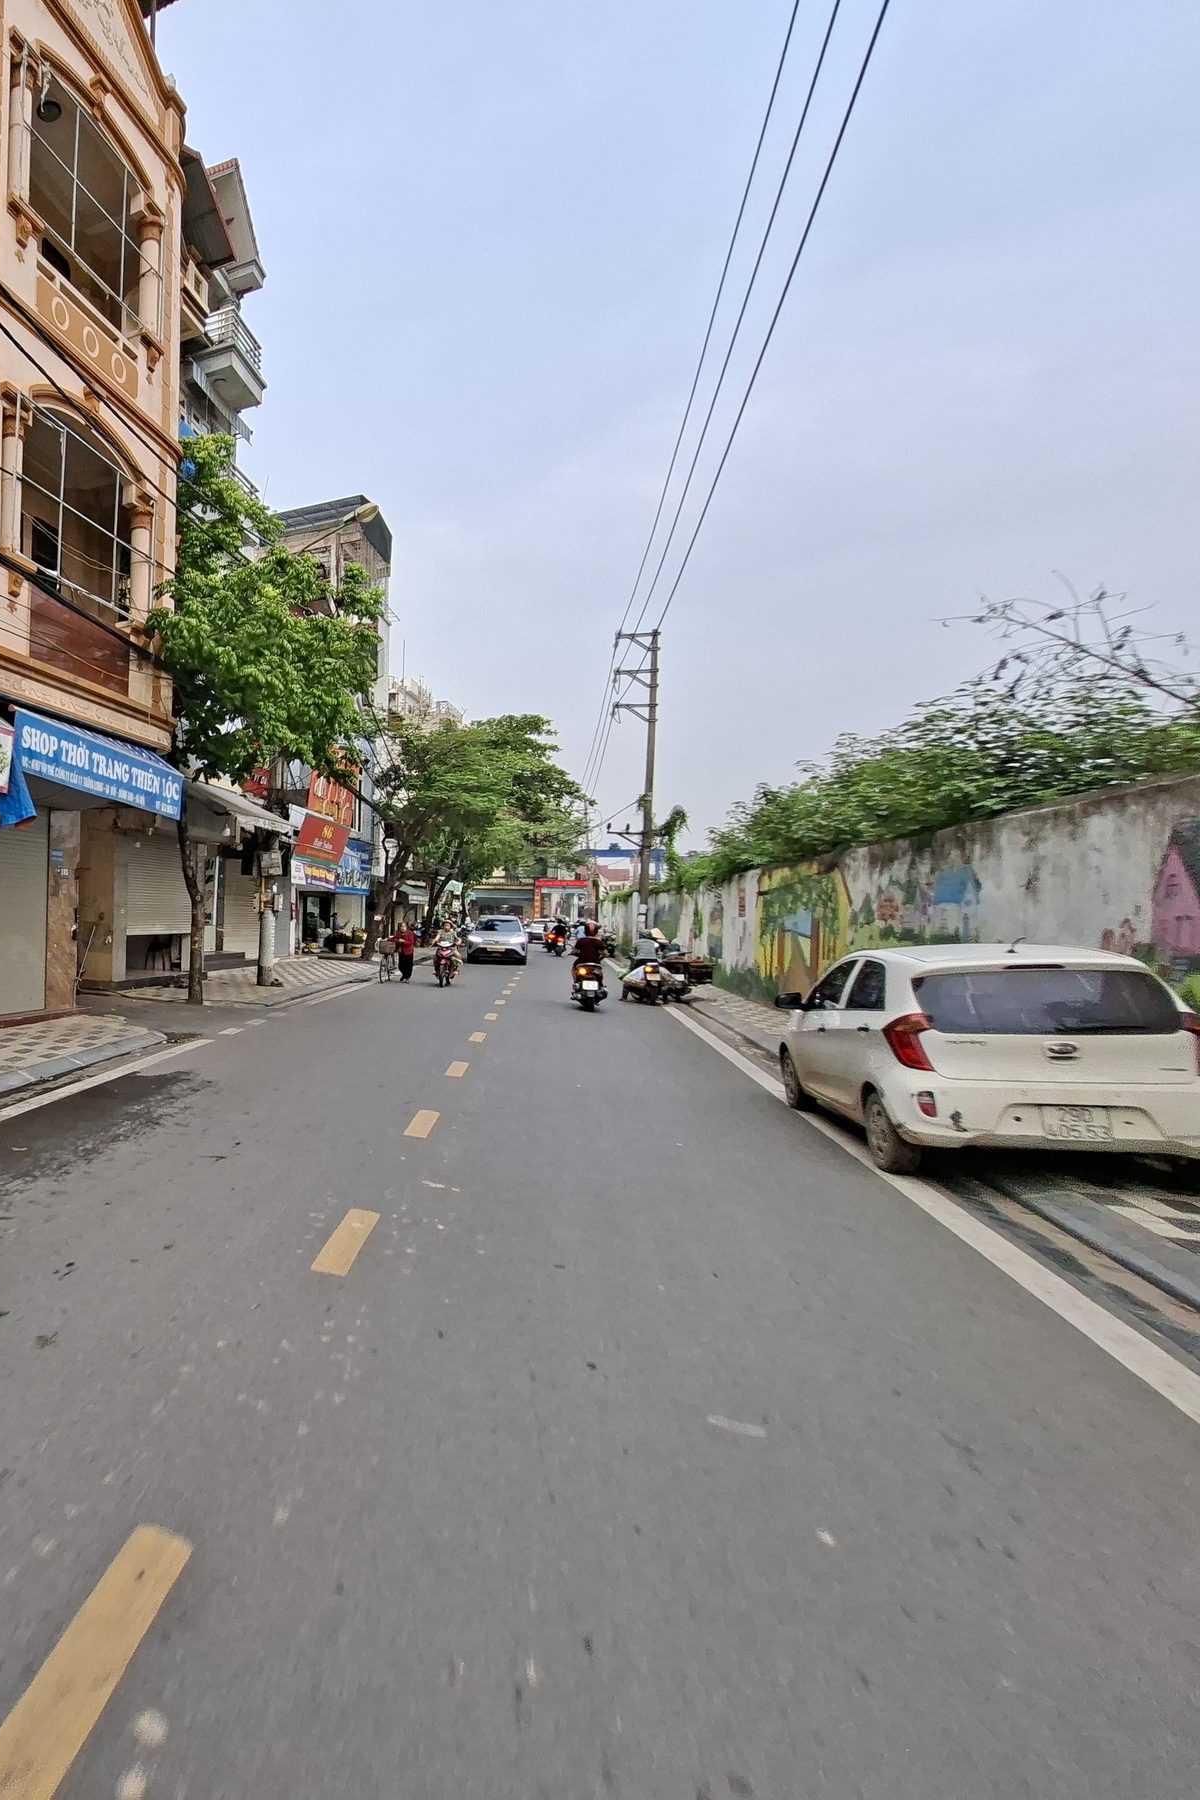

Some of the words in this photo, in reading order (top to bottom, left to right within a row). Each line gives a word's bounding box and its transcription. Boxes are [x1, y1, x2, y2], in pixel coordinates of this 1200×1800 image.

[21, 725, 58, 758] SHOP
[60, 740, 89, 770] THỜI
[92, 752, 130, 783] TRANG
[131, 767, 160, 795] THIÊN
[162, 775, 180, 804] LỘC
[321, 824, 334, 840] 86
